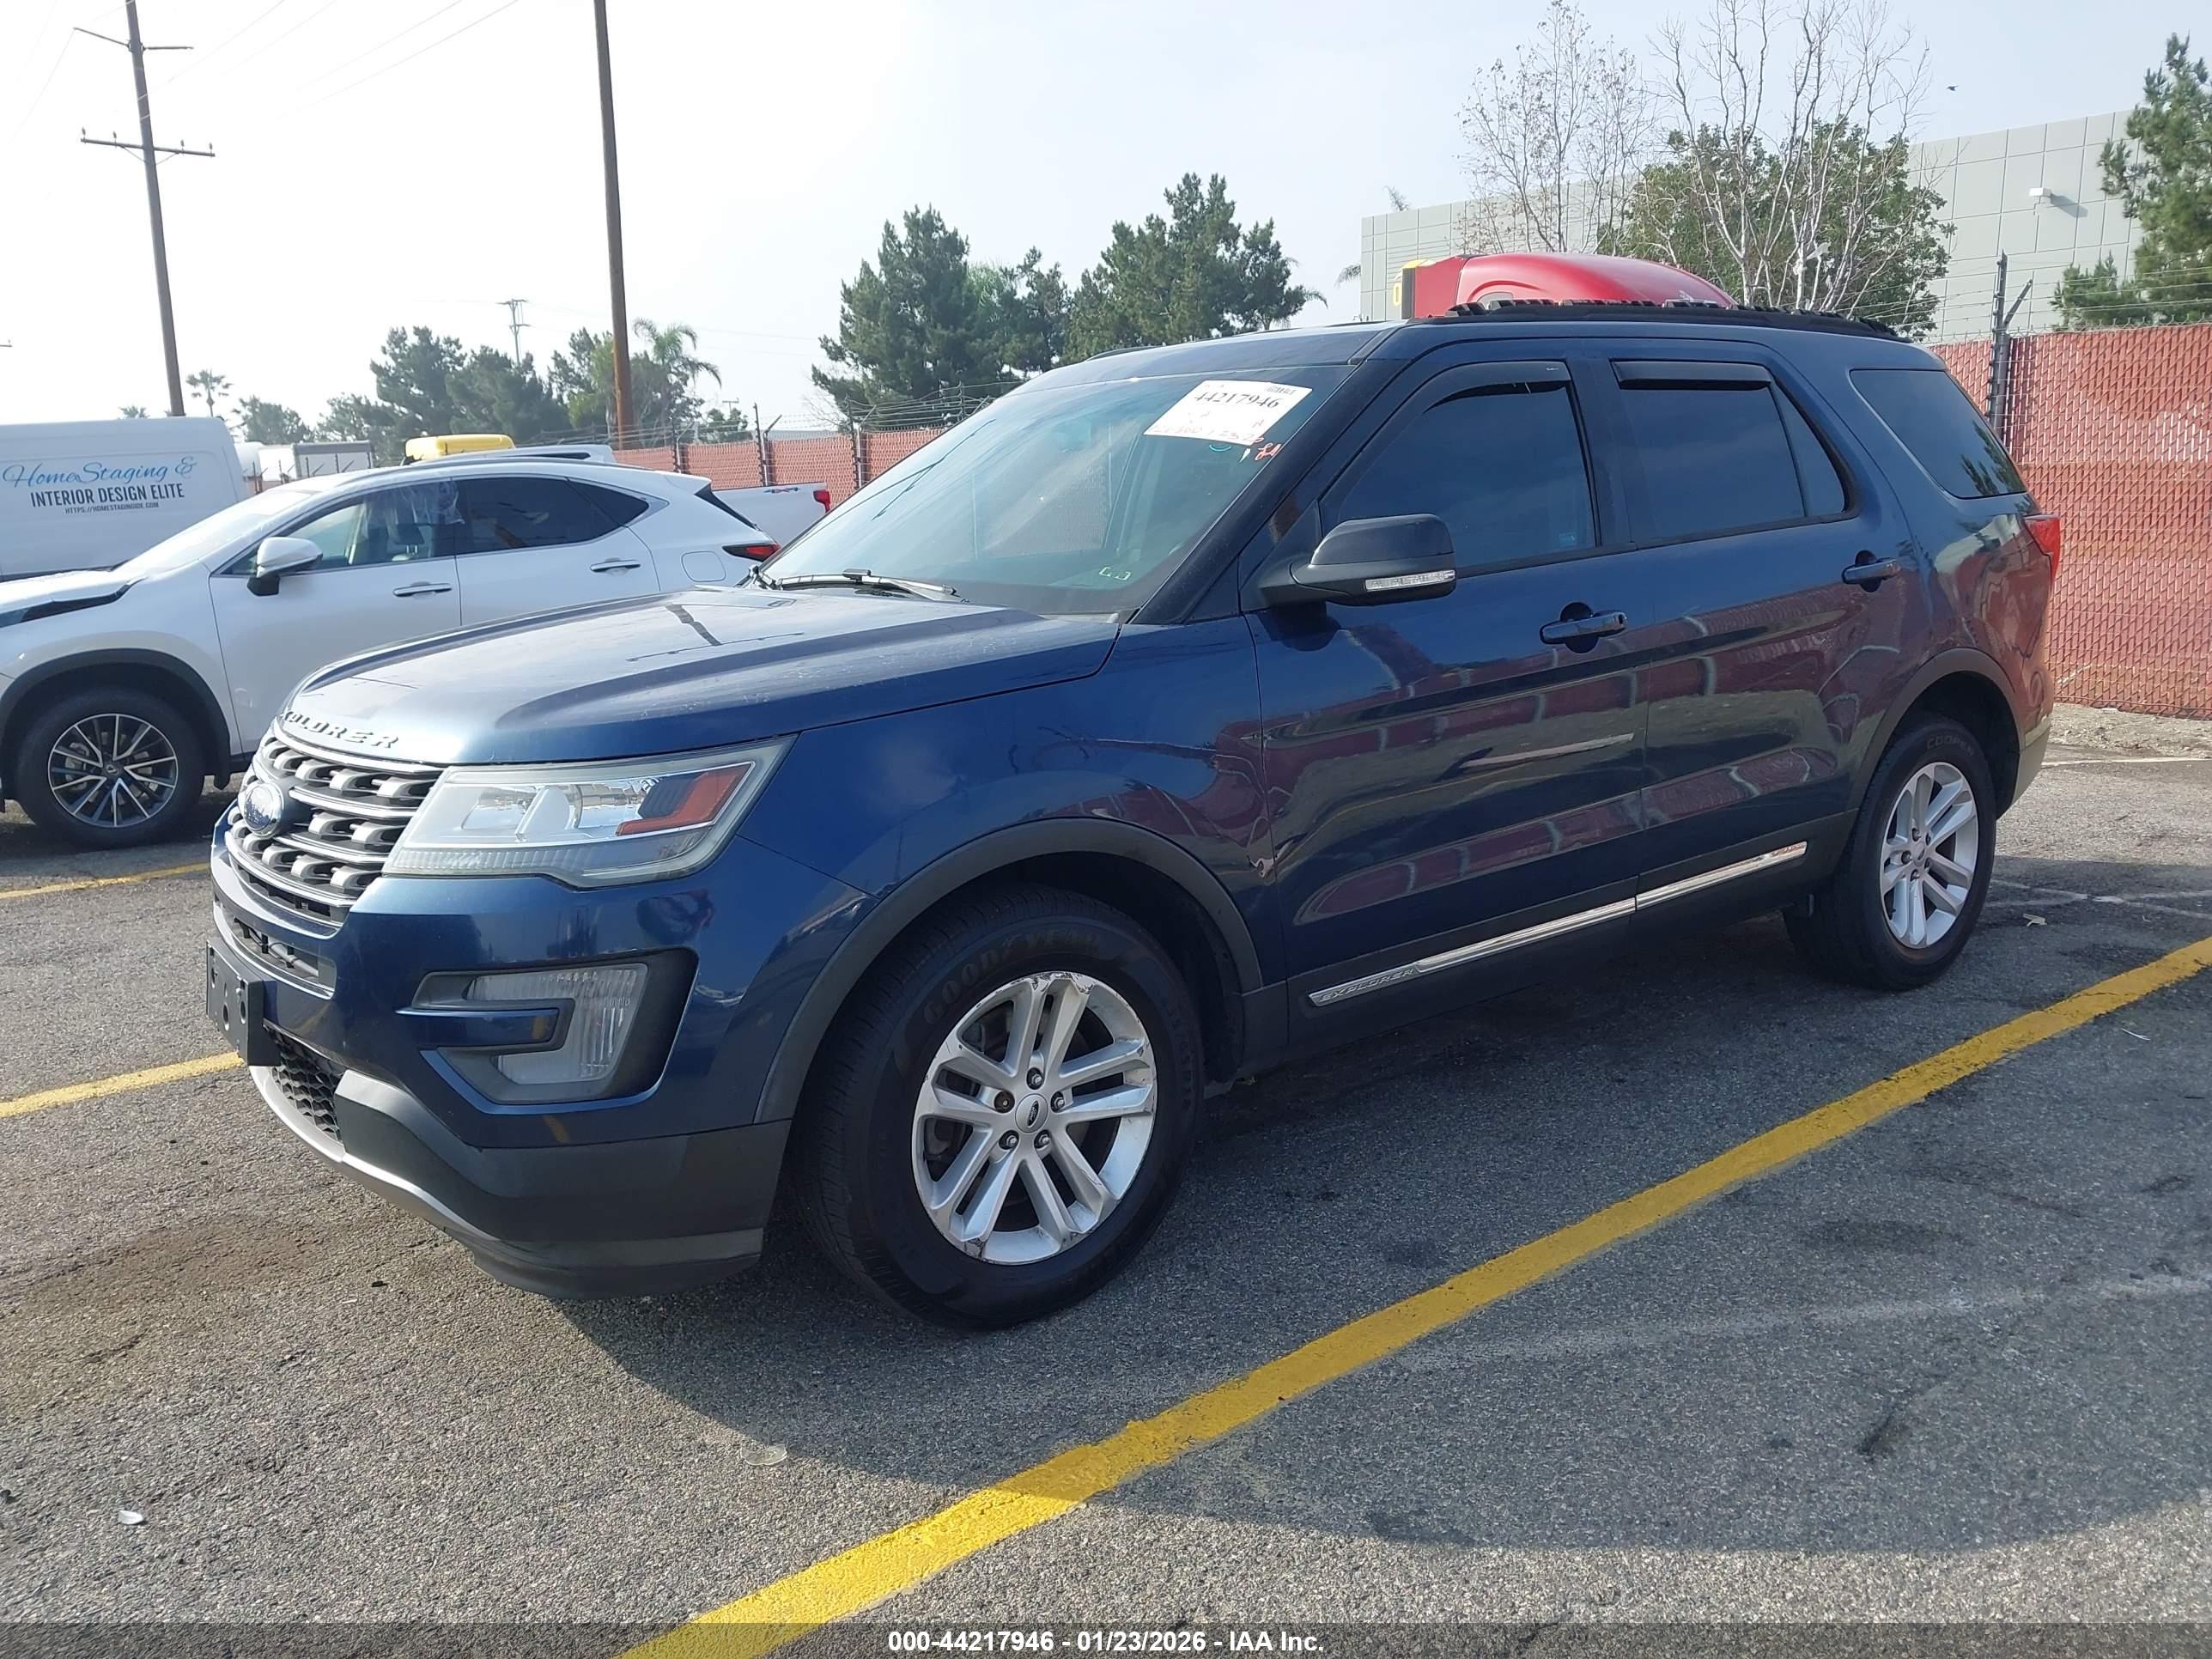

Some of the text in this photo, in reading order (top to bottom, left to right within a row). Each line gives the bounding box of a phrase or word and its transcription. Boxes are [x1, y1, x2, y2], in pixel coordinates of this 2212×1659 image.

[1194, 392, 1283, 408] 44217946
[174, 455, 198, 478] &
[30, 483, 185, 507] INTERIOR DESIGN ELITE
[281, 709, 399, 749] XPLORER
[1318, 968, 1415, 1003] EXPLORER
